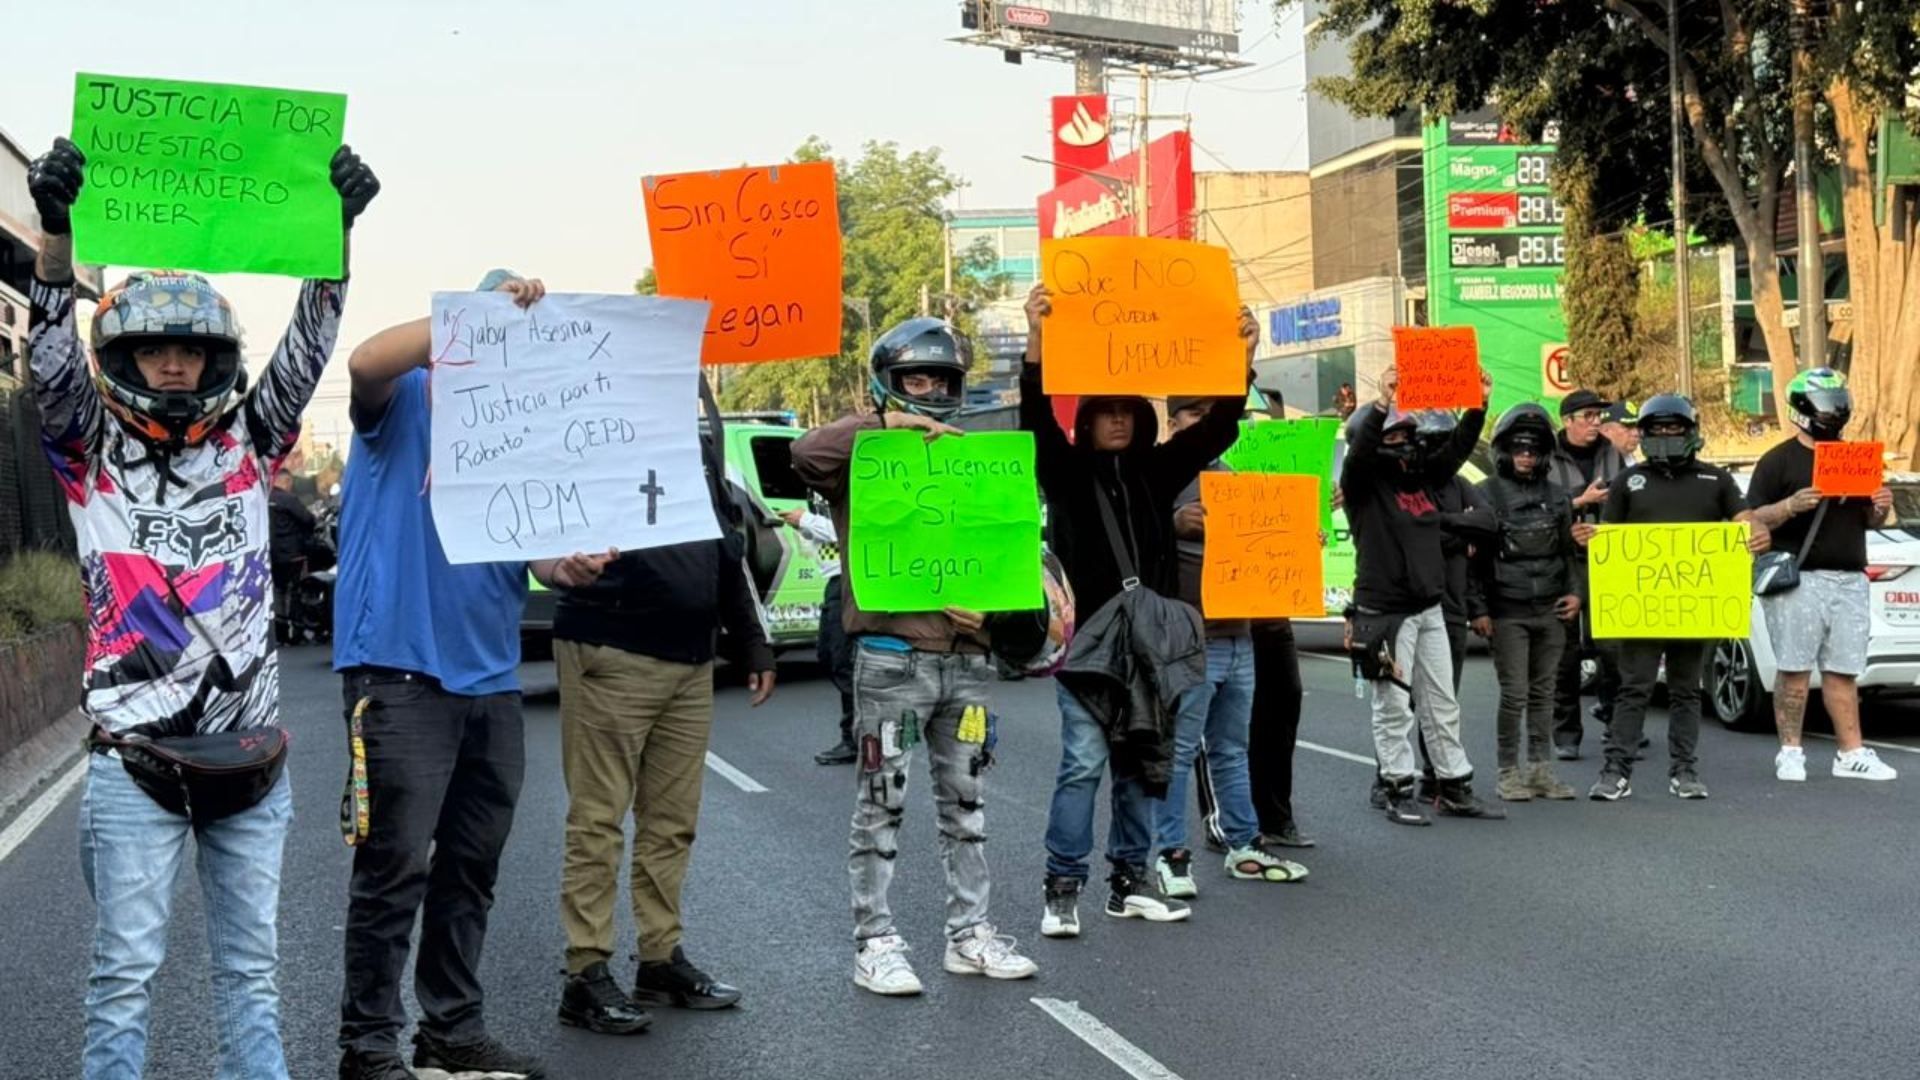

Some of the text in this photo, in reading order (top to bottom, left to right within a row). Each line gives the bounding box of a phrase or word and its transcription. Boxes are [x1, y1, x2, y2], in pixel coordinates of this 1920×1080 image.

[89, 81, 332, 137] JUSTICIA POR
[91, 125, 243, 162] NUESTRO
[90, 160, 289, 205] COMPAÑERO
[653, 172, 820, 232] Sin Casco
[105, 199, 199, 226] BIKER
[1451, 203, 1510, 217] Premium
[1133, 257, 1197, 290] NO
[453, 382, 547, 429] Justicia
[856, 436, 1024, 481] Sin Licencia
[1594, 526, 1752, 566] JUSTICIA
[1637, 558, 1714, 592] PARA
[1599, 592, 1743, 631] ROBERTO
